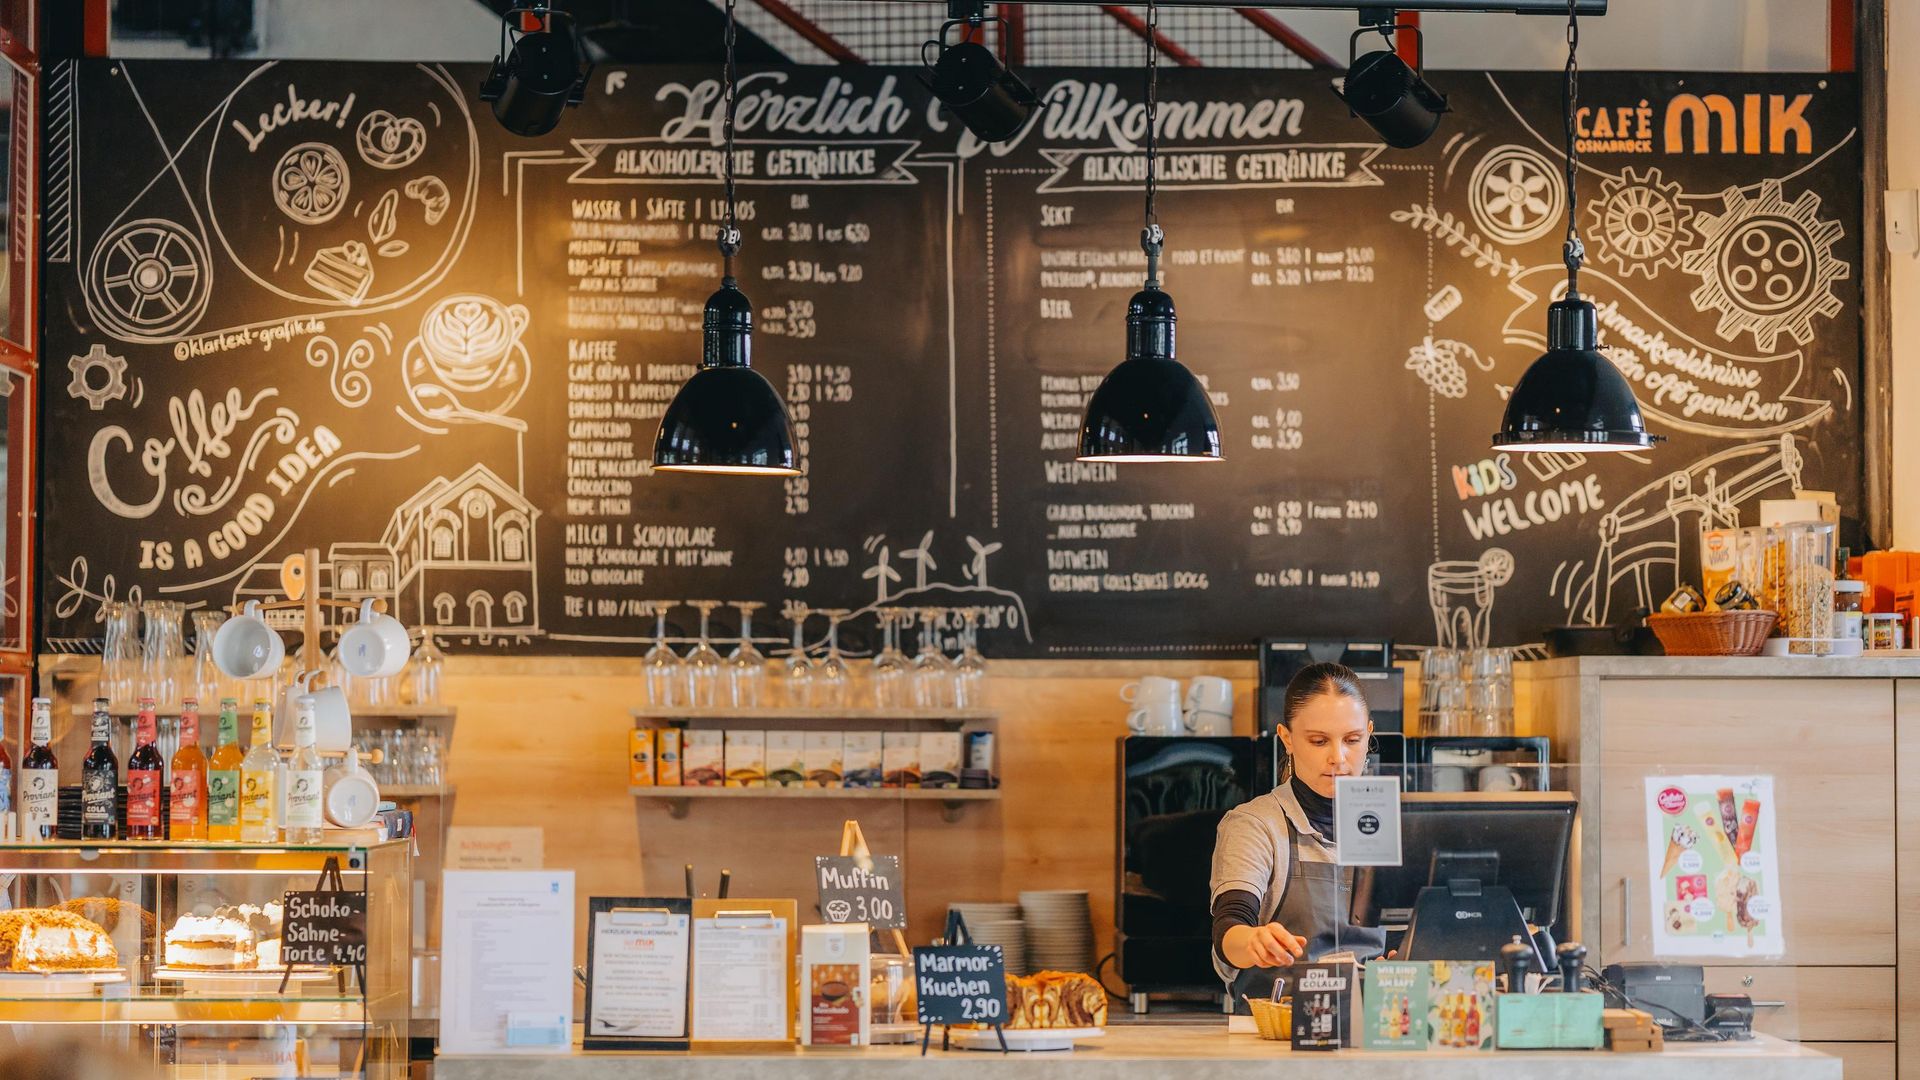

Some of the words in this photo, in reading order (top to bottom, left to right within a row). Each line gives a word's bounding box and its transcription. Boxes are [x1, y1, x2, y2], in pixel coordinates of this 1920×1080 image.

[232, 83, 356, 152] Lecker!
[655, 71, 911, 147] Herzlich
[1576, 99, 1652, 138] CAFÉ
[767, 146, 875, 180] GETRÄNKE
[1236, 150, 1346, 181] GETRÄNKE
[571, 199, 622, 220] WASSER
[646, 198, 687, 220] SÄFTE
[1040, 205, 1074, 226] SEKT
[1040, 298, 1072, 319] BIER
[568, 338, 617, 361] KAFFEE
[1645, 371, 1699, 406] oft
[88, 388, 279, 519] Coffee
[266, 427, 342, 497] IDEA
[567, 457, 597, 478] LATTE
[1463, 474, 1605, 540] WELCOME
[208, 493, 275, 560] GOOD
[566, 523, 608, 545] MILCH
[633, 523, 716, 548] SCHOKOLADE
[139, 541, 174, 571] IS
[184, 540, 203, 570] A
[1047, 548, 1108, 570] ROTWEIN
[564, 595, 585, 617] TEE
[23, 789, 57, 802] Proviant
[820, 866, 890, 892] Muffin
[289, 897, 362, 919] Schoko-
[856, 896, 893, 923] 3.00
[287, 922, 347, 943] Sahne-
[282, 945, 327, 962] Torte
[920, 975, 990, 999] Kuchen
[1309, 971, 1326, 979] OH
